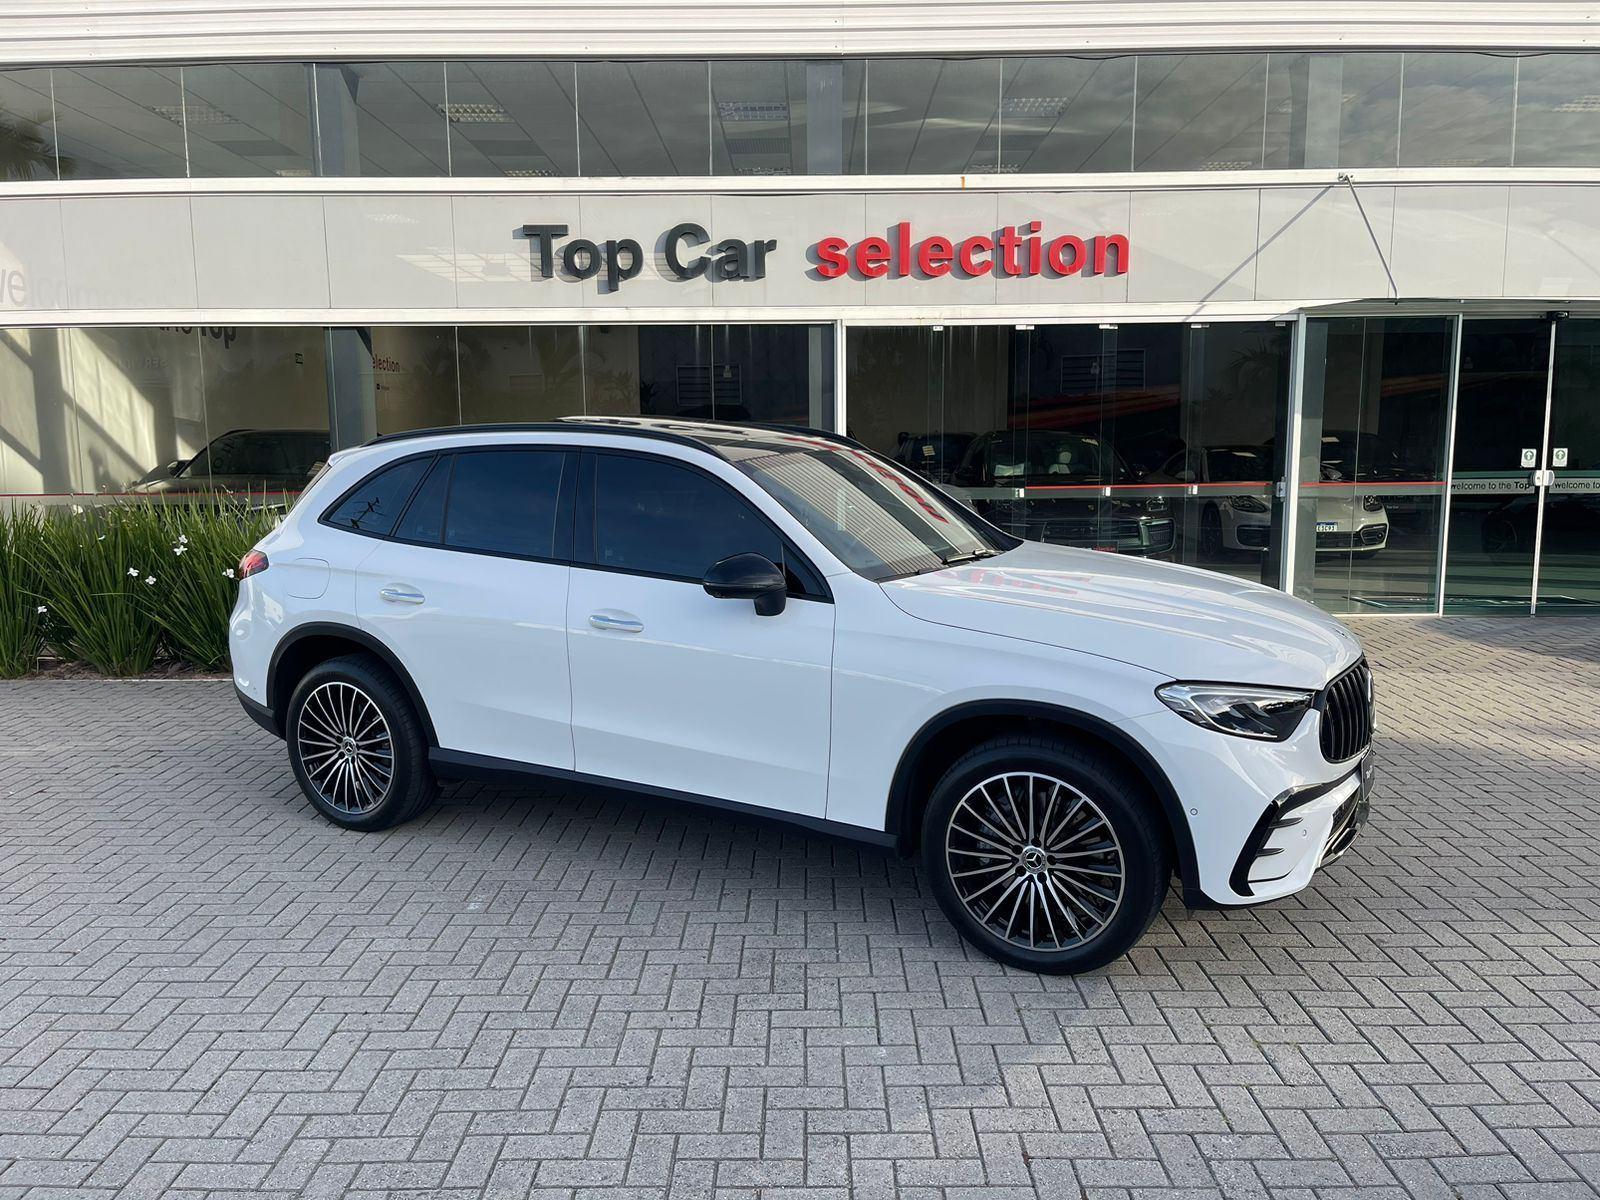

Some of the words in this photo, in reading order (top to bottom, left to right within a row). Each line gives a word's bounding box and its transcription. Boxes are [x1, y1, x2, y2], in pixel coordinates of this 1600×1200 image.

[523, 224, 643, 291] Top
[665, 222, 777, 280] Car
[815, 221, 1129, 278] selection
[373, 354, 400, 373] election
[1451, 482, 1486, 490] welcome
[1488, 481, 1496, 490] to
[1498, 481, 1512, 490] the
[1514, 481, 1530, 491] Top
[1554, 481, 1590, 489] welcome
